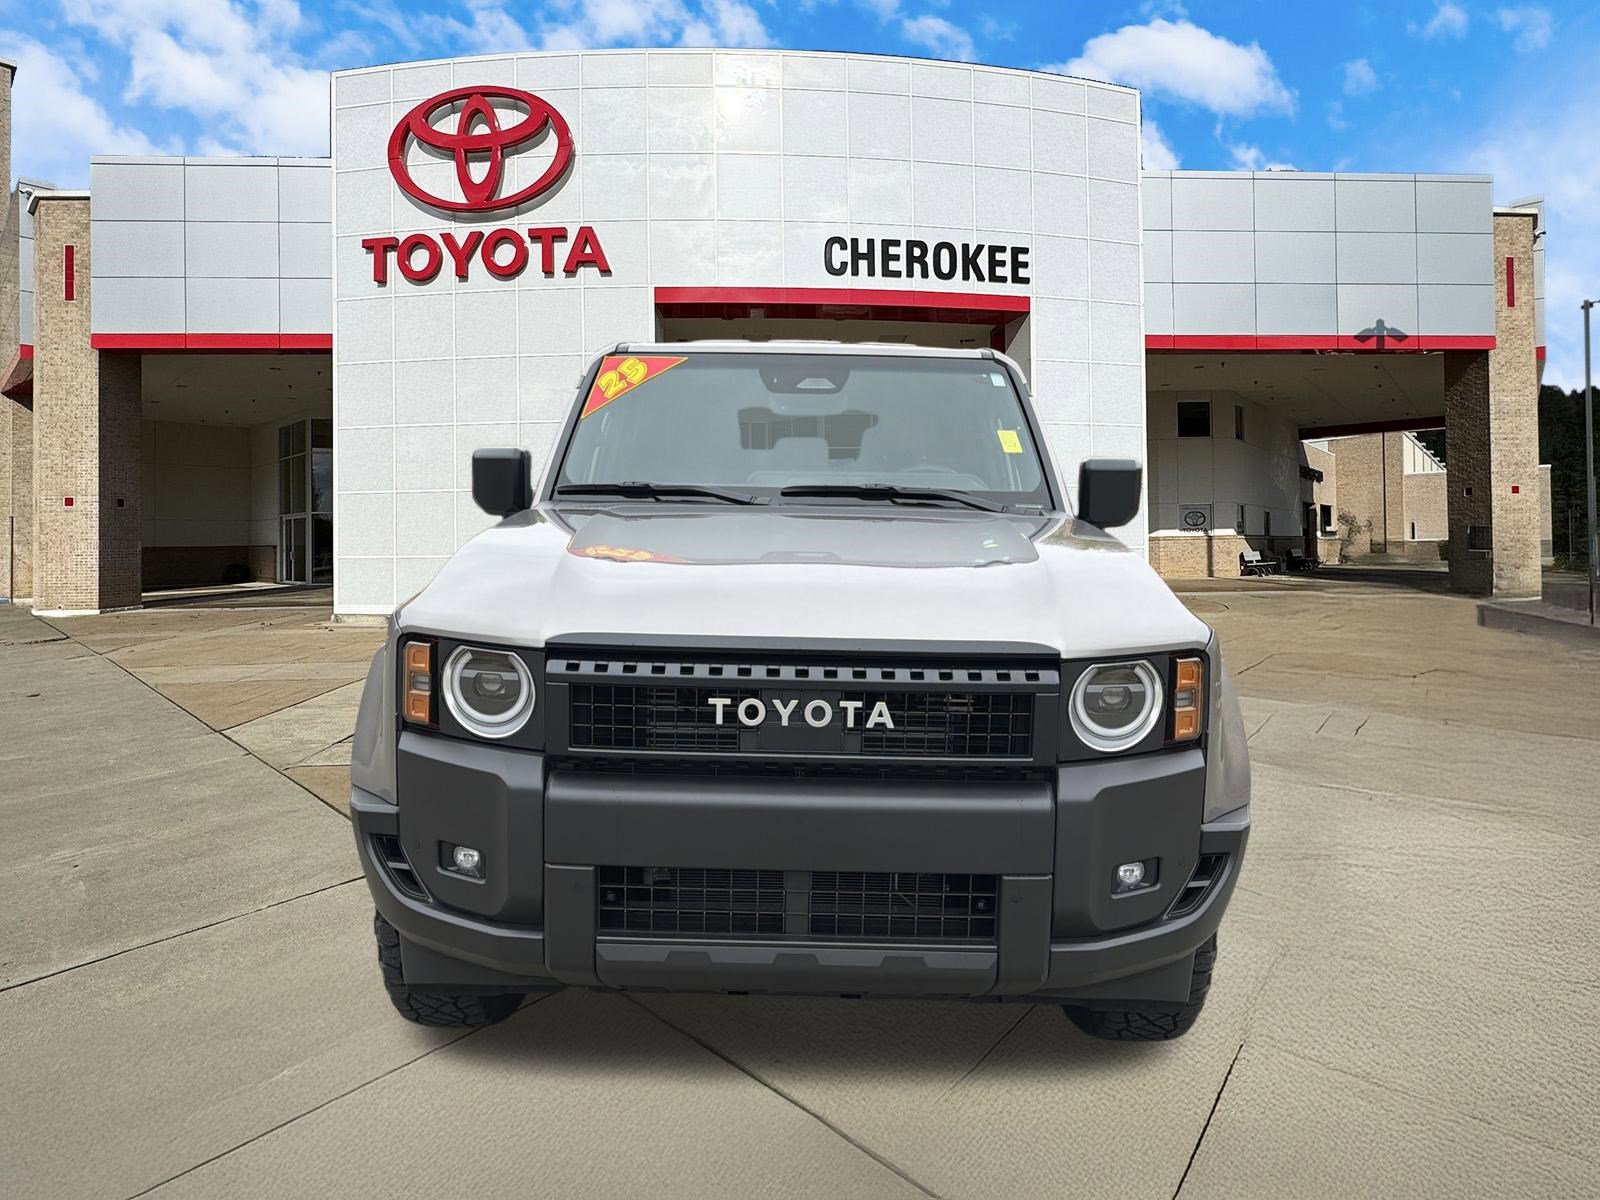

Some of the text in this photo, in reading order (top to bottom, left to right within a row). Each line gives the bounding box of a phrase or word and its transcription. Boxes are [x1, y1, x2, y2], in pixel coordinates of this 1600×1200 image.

[362, 226, 612, 286] TOYOTA
[824, 236, 1030, 284] CHEROKEE
[597, 357, 648, 399] 25
[707, 697, 895, 729] TOYOTA
